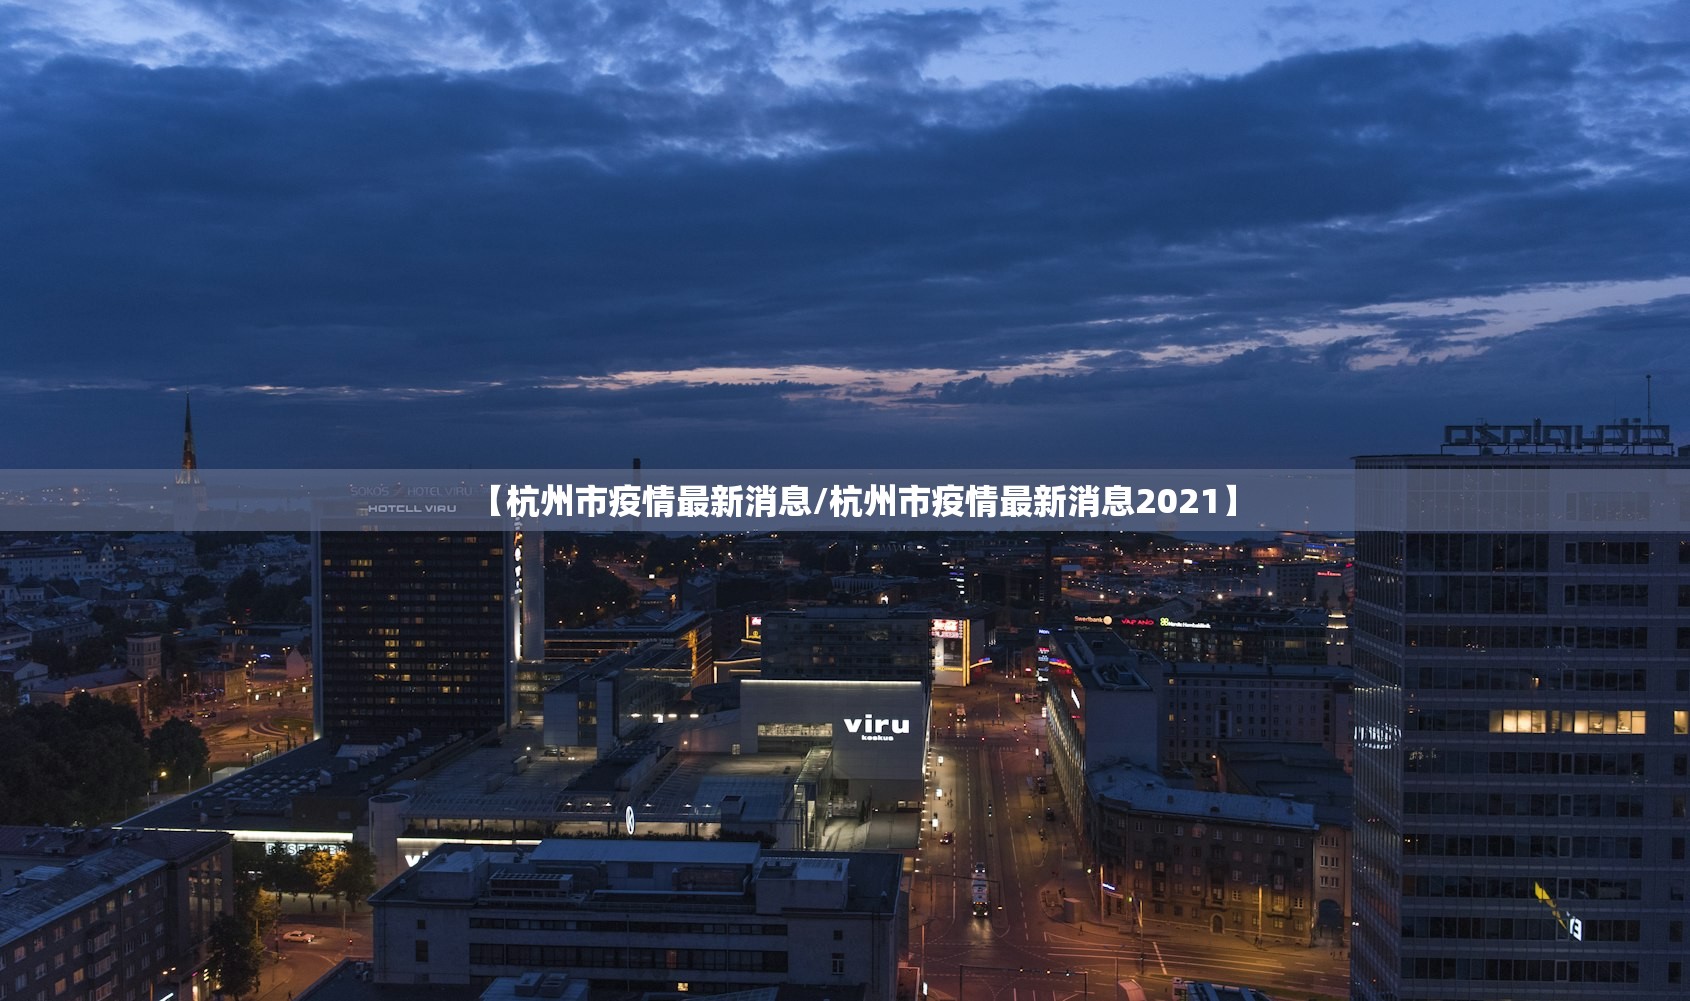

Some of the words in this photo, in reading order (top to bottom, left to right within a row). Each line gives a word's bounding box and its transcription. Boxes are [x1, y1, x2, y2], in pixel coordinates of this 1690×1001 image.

[351, 486, 389, 496] SOKOS
[407, 486, 441, 496] HOTEL
[445, 486, 473, 496] VIRU
[425, 505, 457, 513] VIRU
[843, 714, 910, 733] viru
